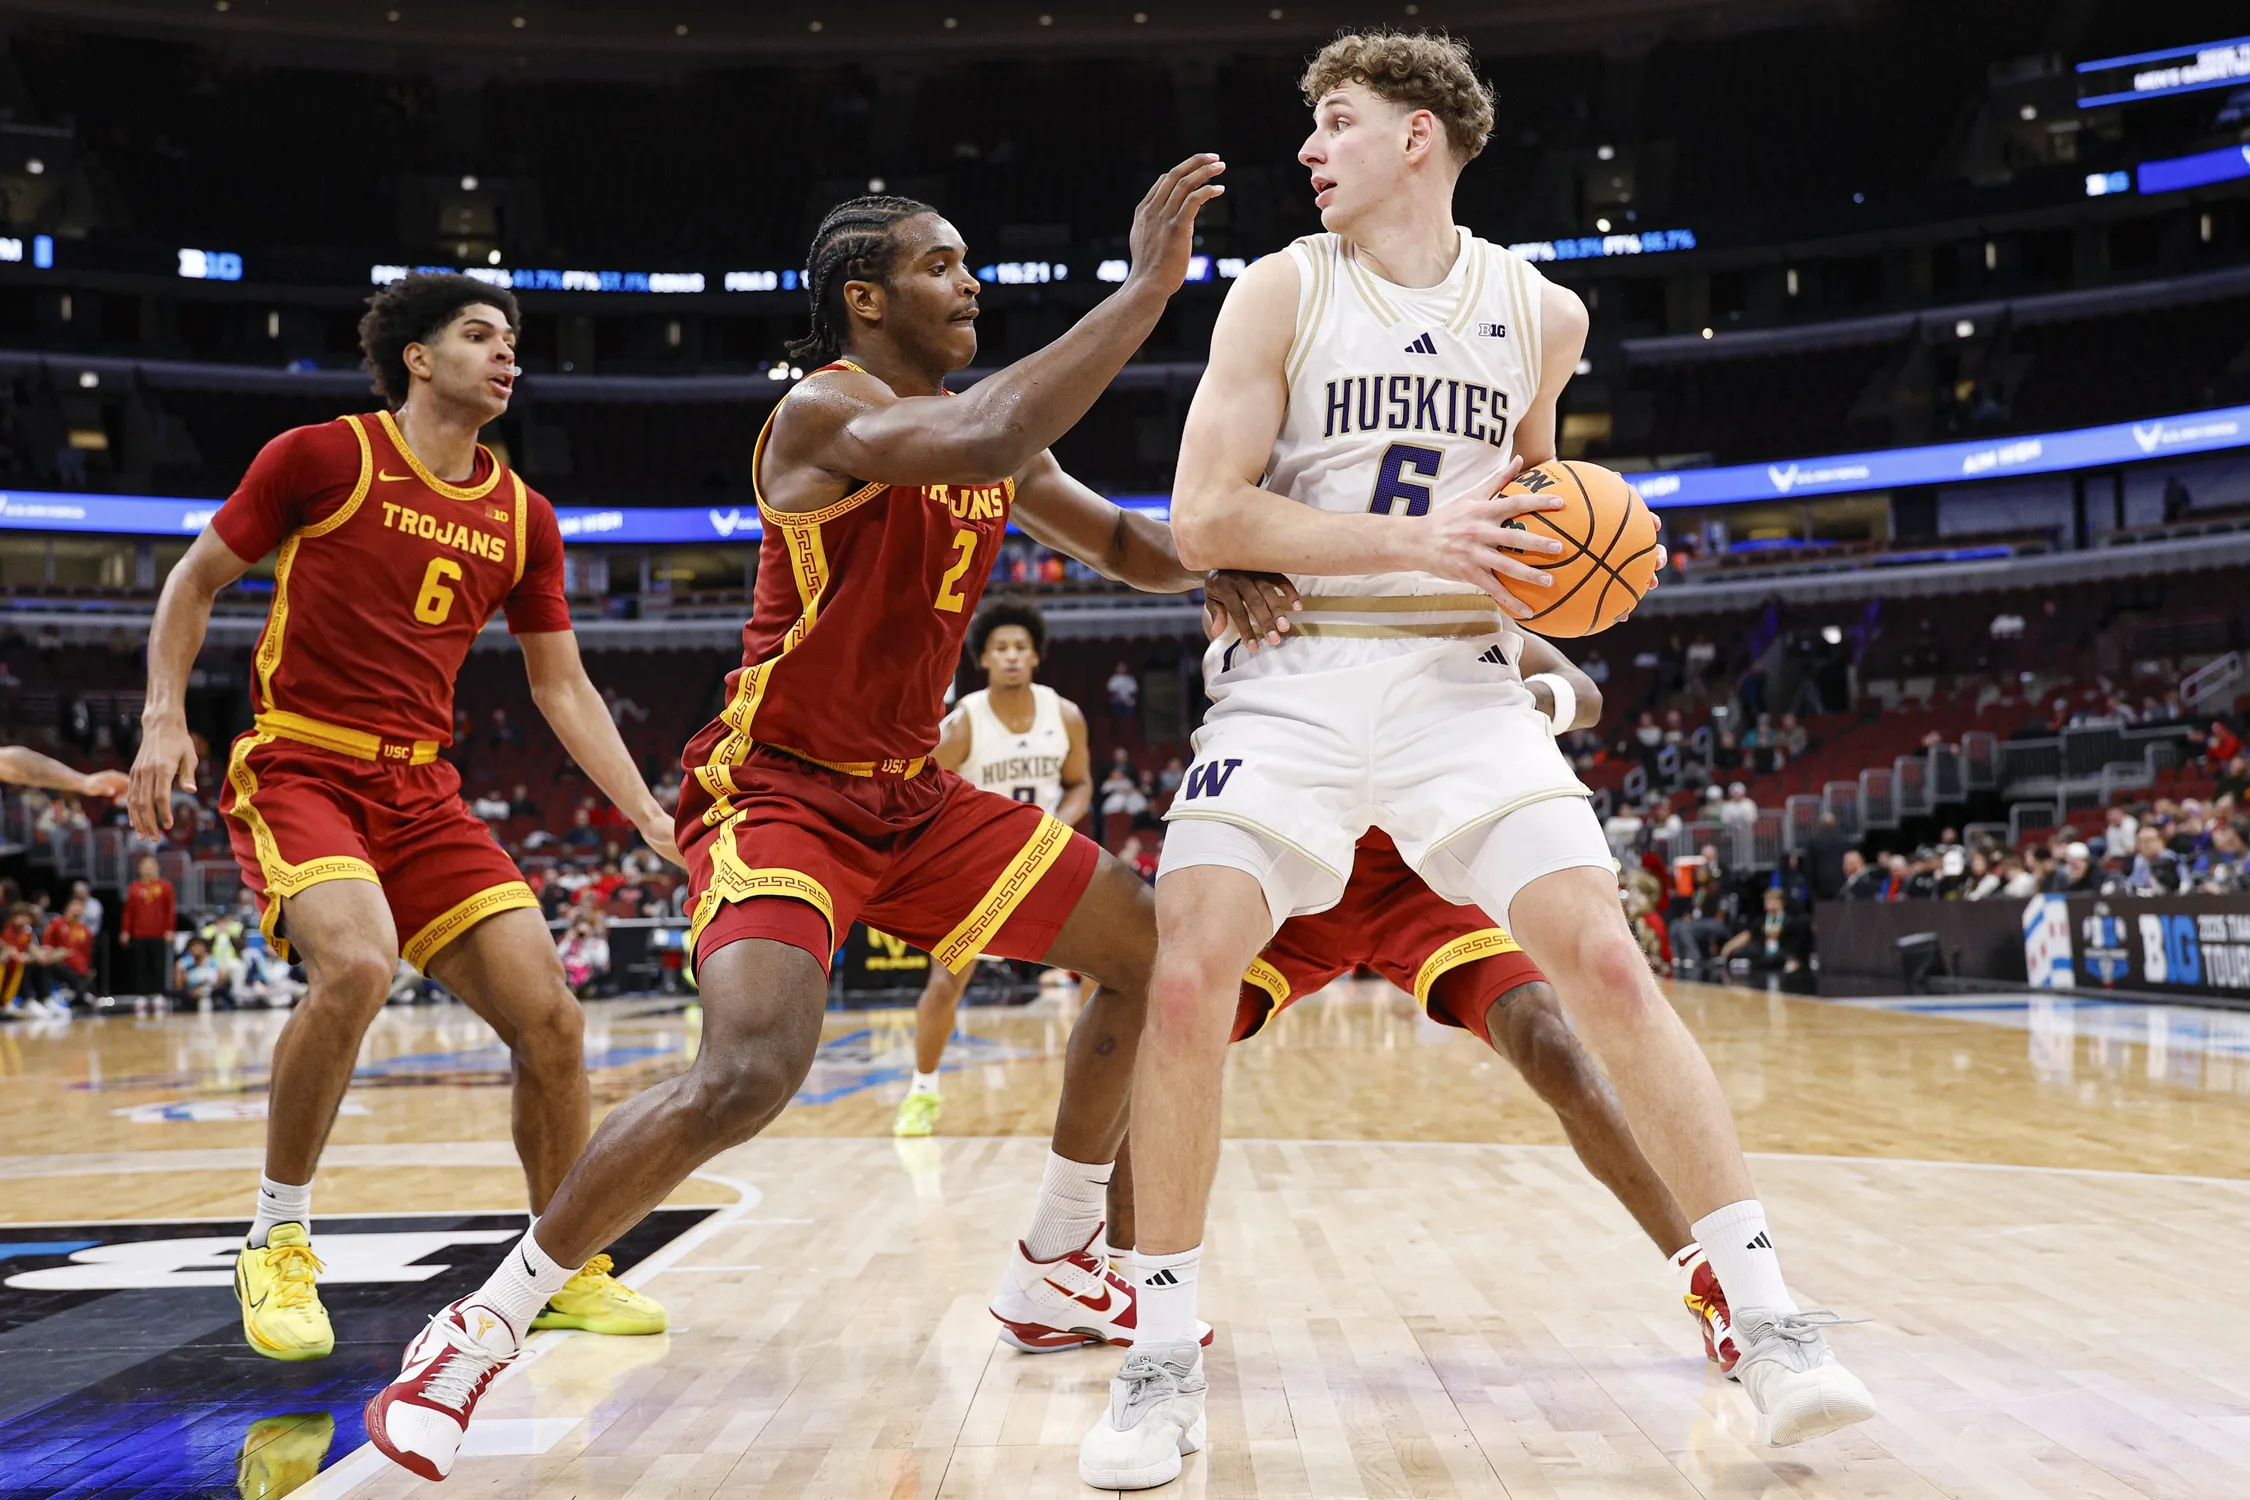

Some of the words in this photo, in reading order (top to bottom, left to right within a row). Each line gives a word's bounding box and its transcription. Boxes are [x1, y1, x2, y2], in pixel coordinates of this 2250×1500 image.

[1322, 374, 1510, 449] HUSKIES
[1366, 441, 1446, 516] 6
[382, 501, 507, 563] TROJANS
[413, 556, 463, 626] 6
[934, 528, 978, 614] 2
[383, 744, 410, 759] USC
[881, 759, 906, 774] USC
[982, 756, 1062, 785] HUSKIES
[1185, 758, 1243, 801] W
